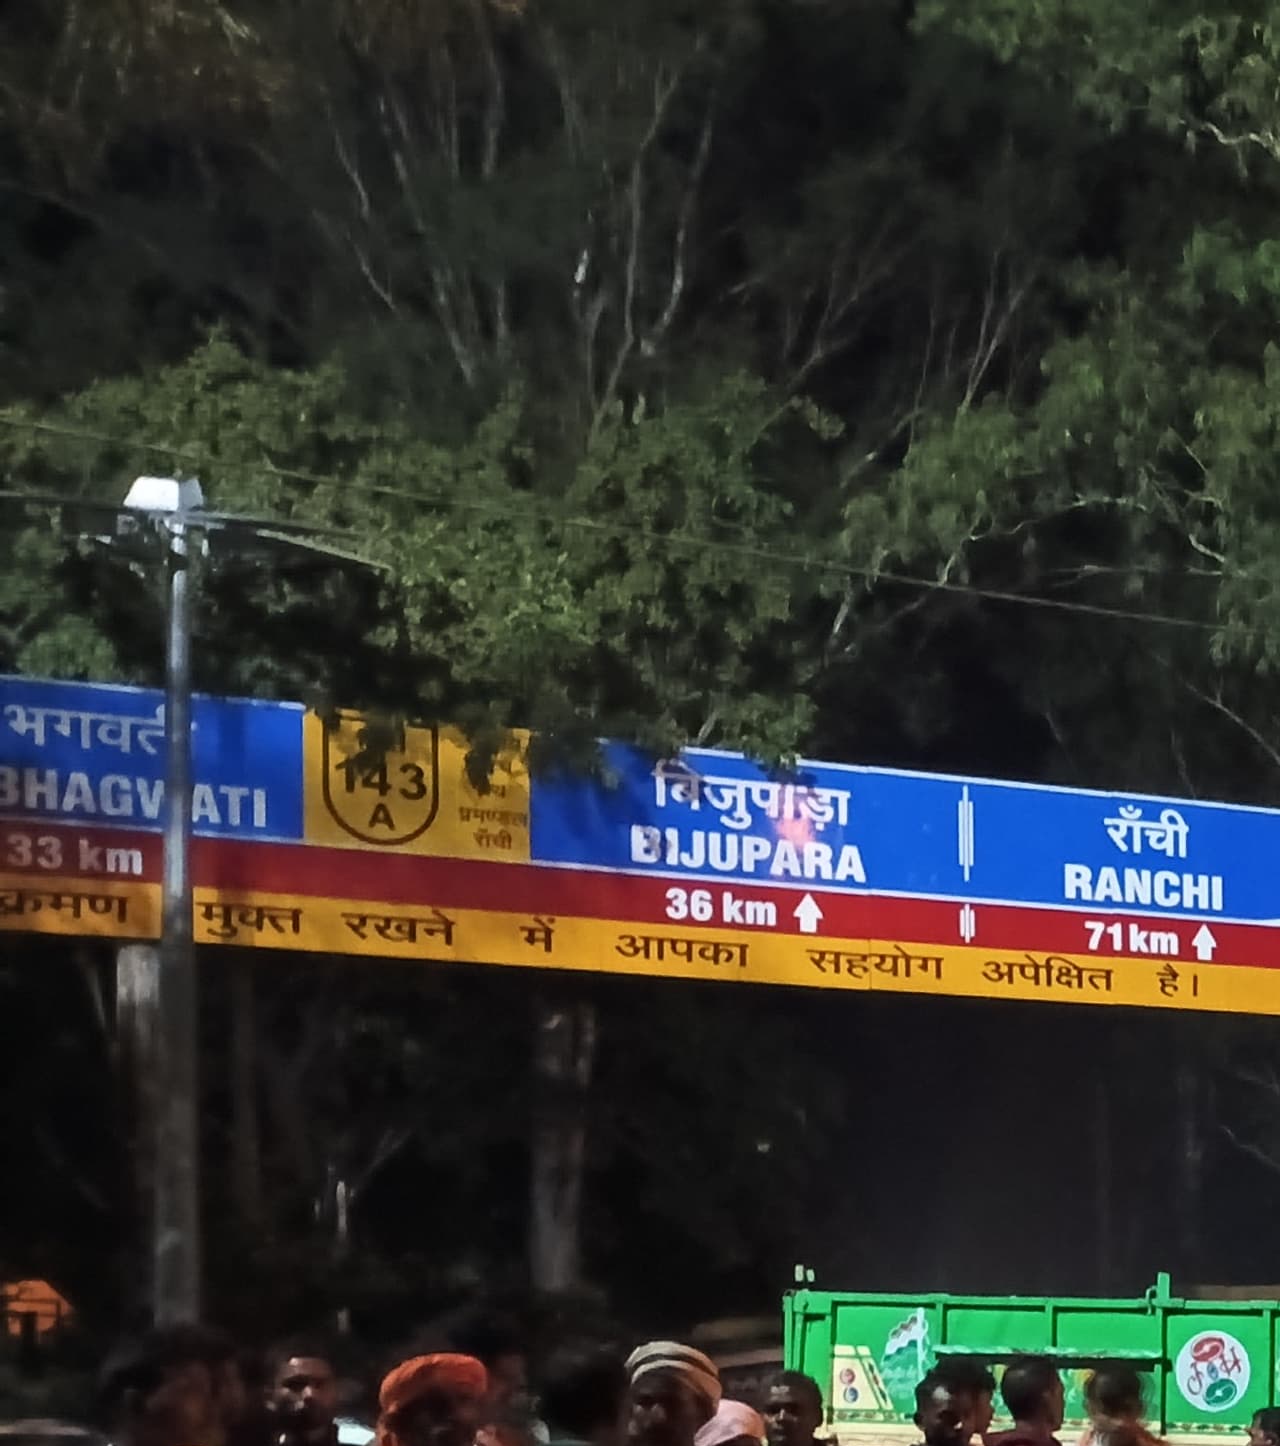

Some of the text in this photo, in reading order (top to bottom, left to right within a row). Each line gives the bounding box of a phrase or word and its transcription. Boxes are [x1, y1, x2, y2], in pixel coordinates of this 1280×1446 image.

[4, 703, 166, 755] भगवत
[369, 803, 395, 831] A
[7, 834, 143, 876] 33 km
[630, 823, 867, 883] BIJUPARA
[665, 888, 777, 926] 36 km
[1064, 863, 1224, 911] RANCHI
[195, 902, 304, 938] मुक्त
[340, 909, 456, 947] रखने
[519, 917, 556, 953] में
[615, 934, 749, 968] आपका
[806, 945, 944, 980] सहयोग
[982, 954, 1114, 992] अपेक्षित
[1084, 921, 1179, 955] 71 km
